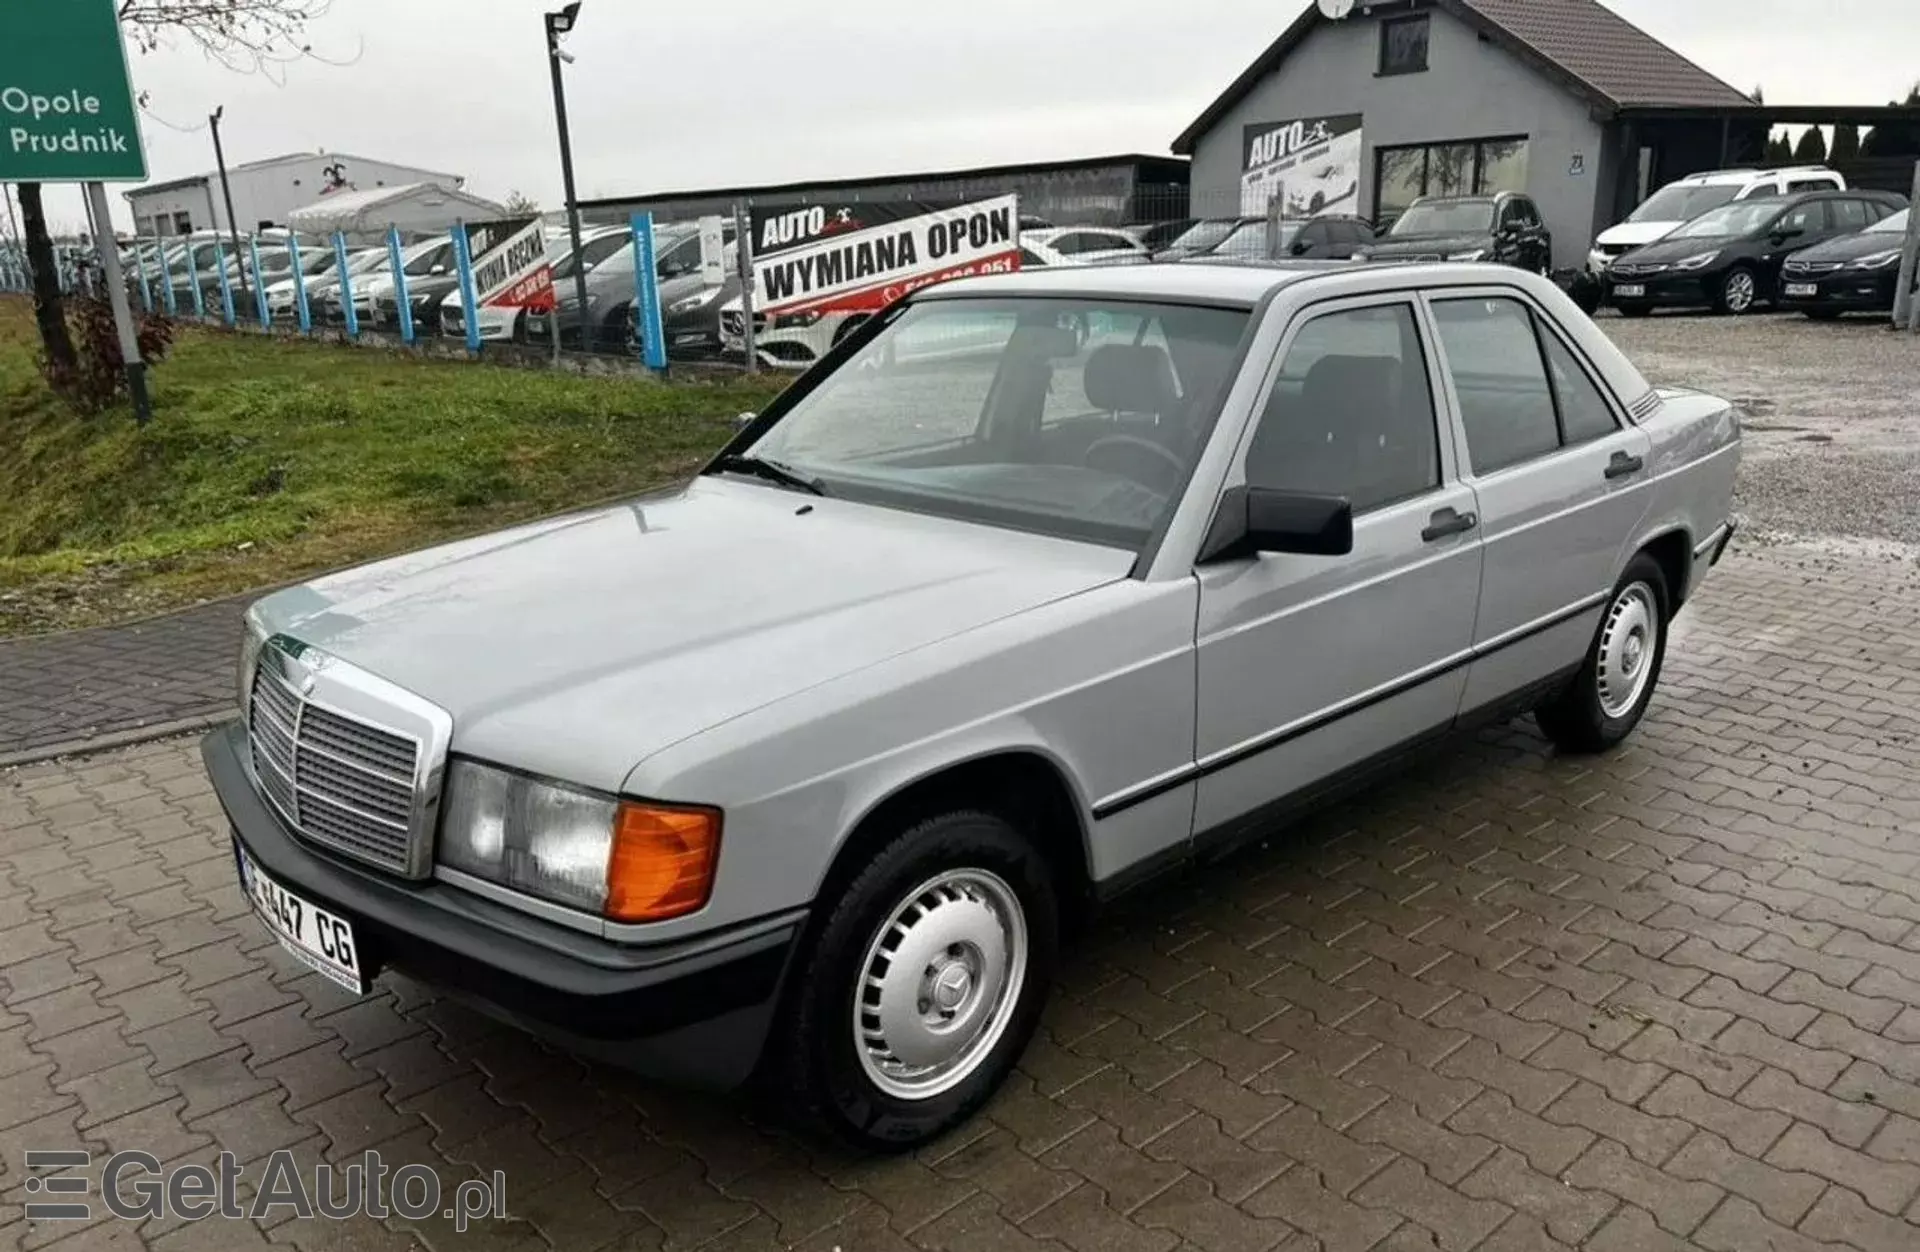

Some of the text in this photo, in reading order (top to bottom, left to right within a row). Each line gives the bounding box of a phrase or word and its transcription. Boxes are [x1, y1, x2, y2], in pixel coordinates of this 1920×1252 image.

[2, 87, 100, 120] Opole
[10, 127, 128, 152] Prudnik
[1248, 120, 1304, 170] AUTO
[761, 206, 825, 248] AUTO
[763, 231, 918, 301] WYMIANA
[927, 207, 1010, 260] OPON
[315, 910, 354, 969] CG
